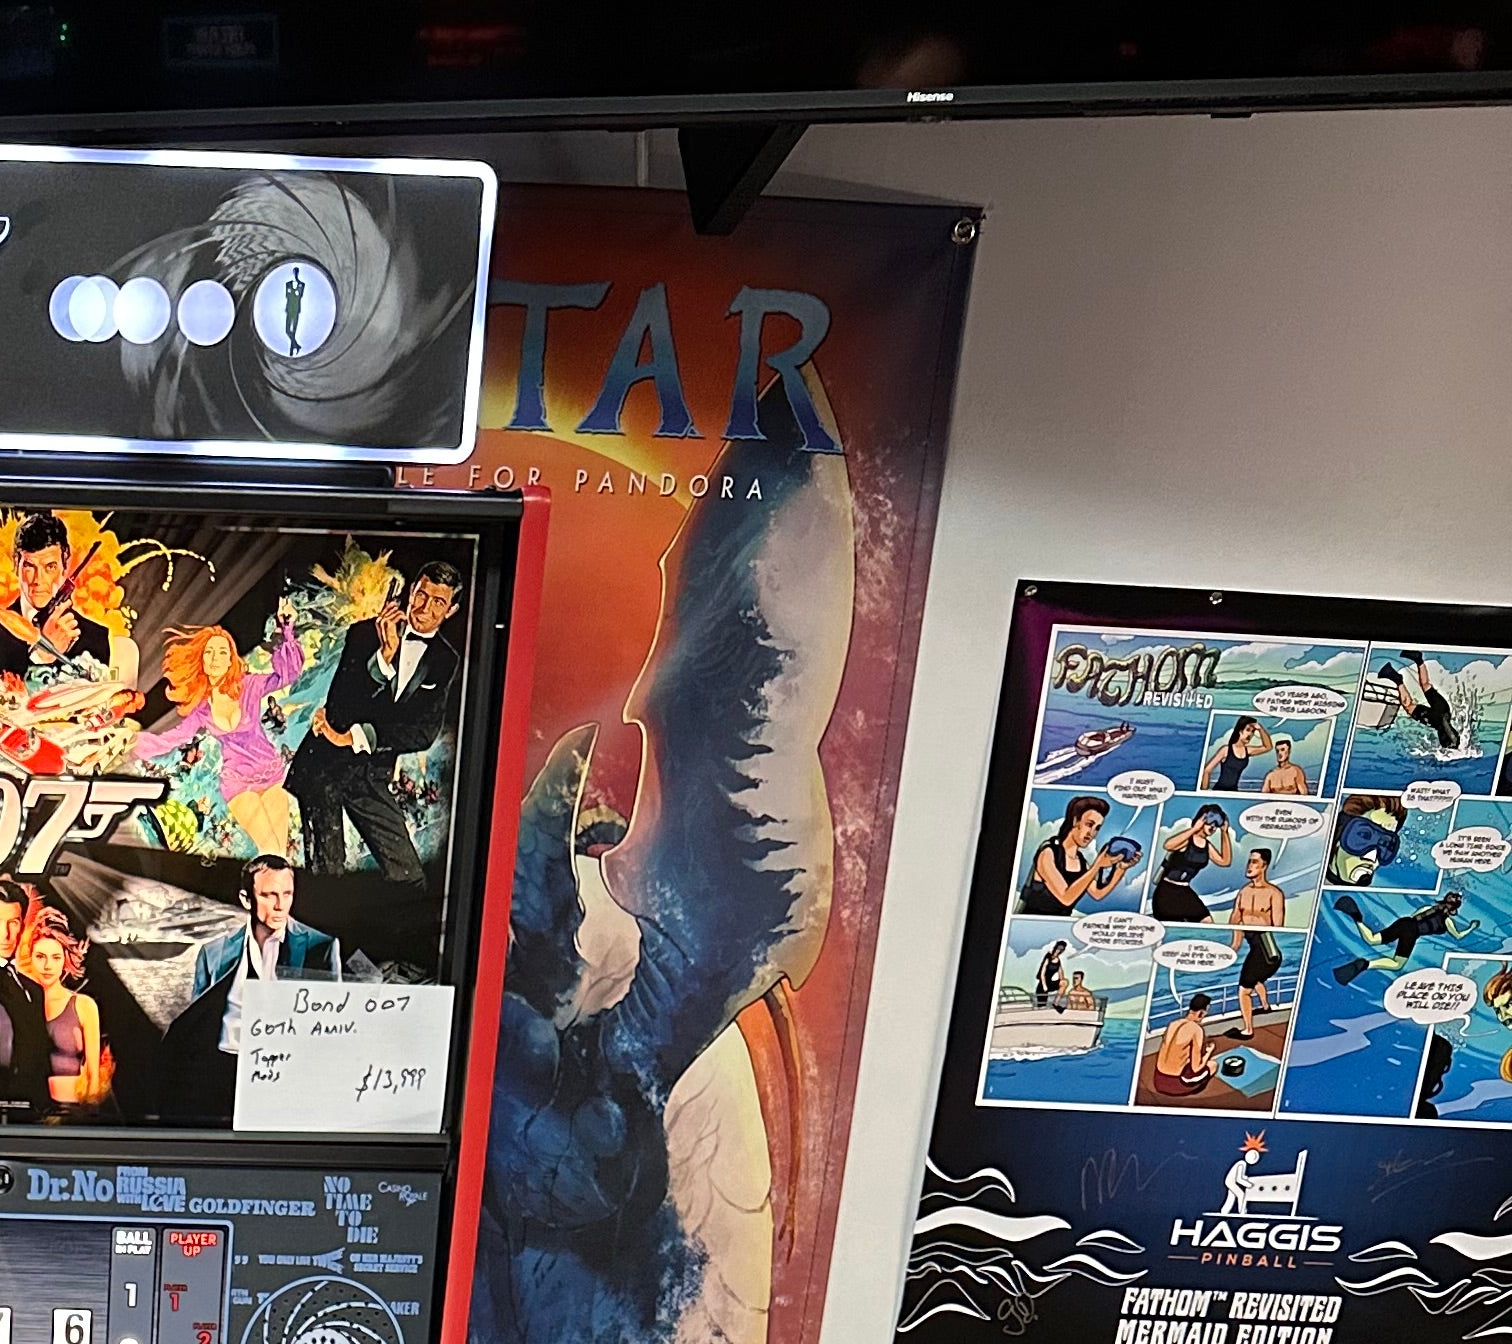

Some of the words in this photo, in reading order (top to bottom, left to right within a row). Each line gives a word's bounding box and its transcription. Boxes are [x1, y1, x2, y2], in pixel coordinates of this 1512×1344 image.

[906, 90, 954, 104] Hisense
[469, 465, 541, 488] FOR
[575, 469, 762, 501] PANDORA
[1054, 643, 1221, 706] FATHOM
[1143, 690, 1213, 709] REVISITED
[294, 988, 350, 1014] Bond
[365, 997, 410, 1012] 007
[355, 1064, 426, 1102] $13,999
[116, 1176, 186, 1195] RUSSIA
[323, 1176, 351, 1193] NO
[189, 1198, 316, 1216] GOLDFINGER
[324, 1193, 373, 1211] TIME
[336, 1210, 362, 1227] TO
[115, 1230, 152, 1246] BALL
[170, 1232, 217, 1246] PLAYER
[347, 1226, 379, 1244] DIE
[1170, 1219, 1343, 1252] HAGGIS
[183, 1245, 201, 1257] UP
[1201, 1252, 1297, 1268] PINBALL
[124, 1282, 137, 1308] 1
[169, 1293, 179, 1311] 1
[1228, 1292, 1342, 1323] REVISITED
